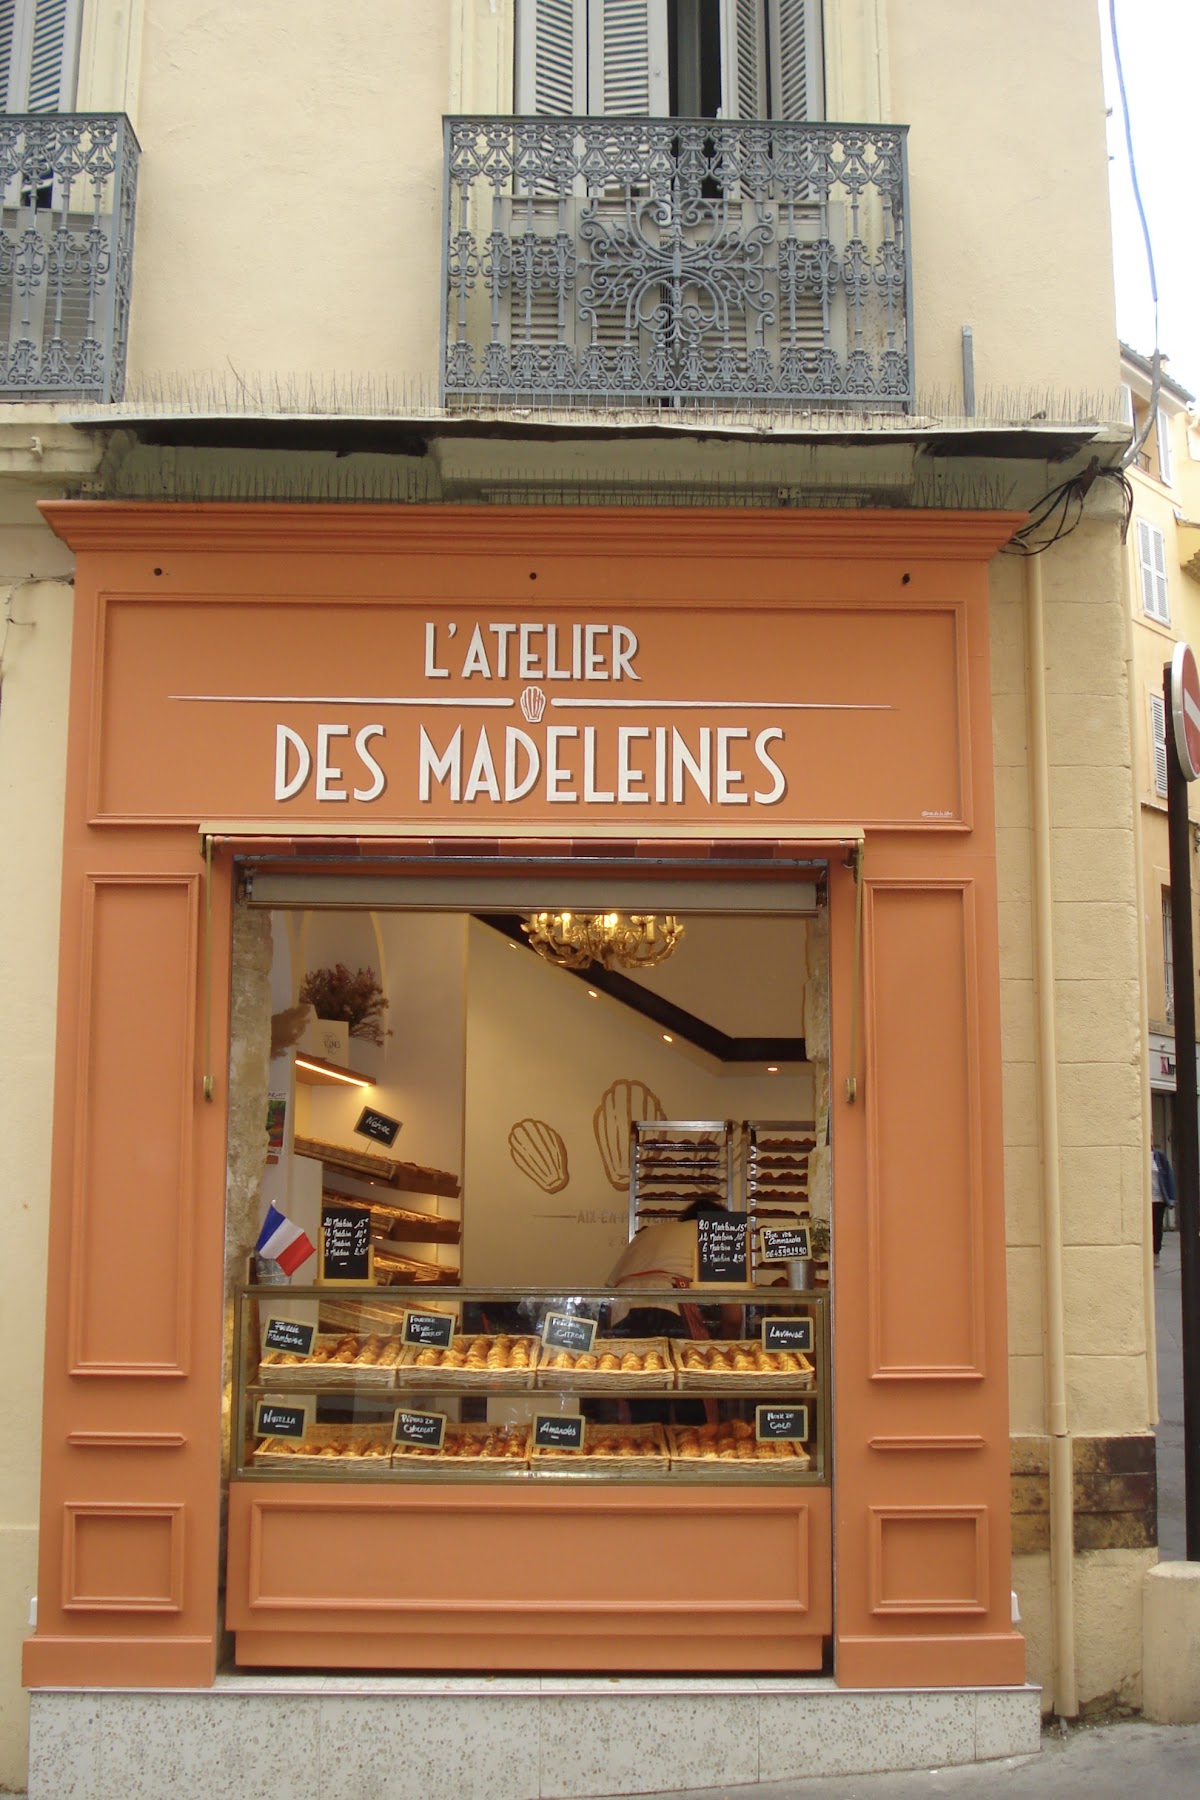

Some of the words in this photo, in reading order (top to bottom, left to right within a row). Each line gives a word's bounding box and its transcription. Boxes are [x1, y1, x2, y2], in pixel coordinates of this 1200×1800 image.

[424, 622, 641, 680] L'ATELIER
[274, 724, 386, 802] DES
[418, 724, 786, 805] MADELEINES
[702, 1242, 708, 1253] 6
[702, 1253, 708, 1263] 3
